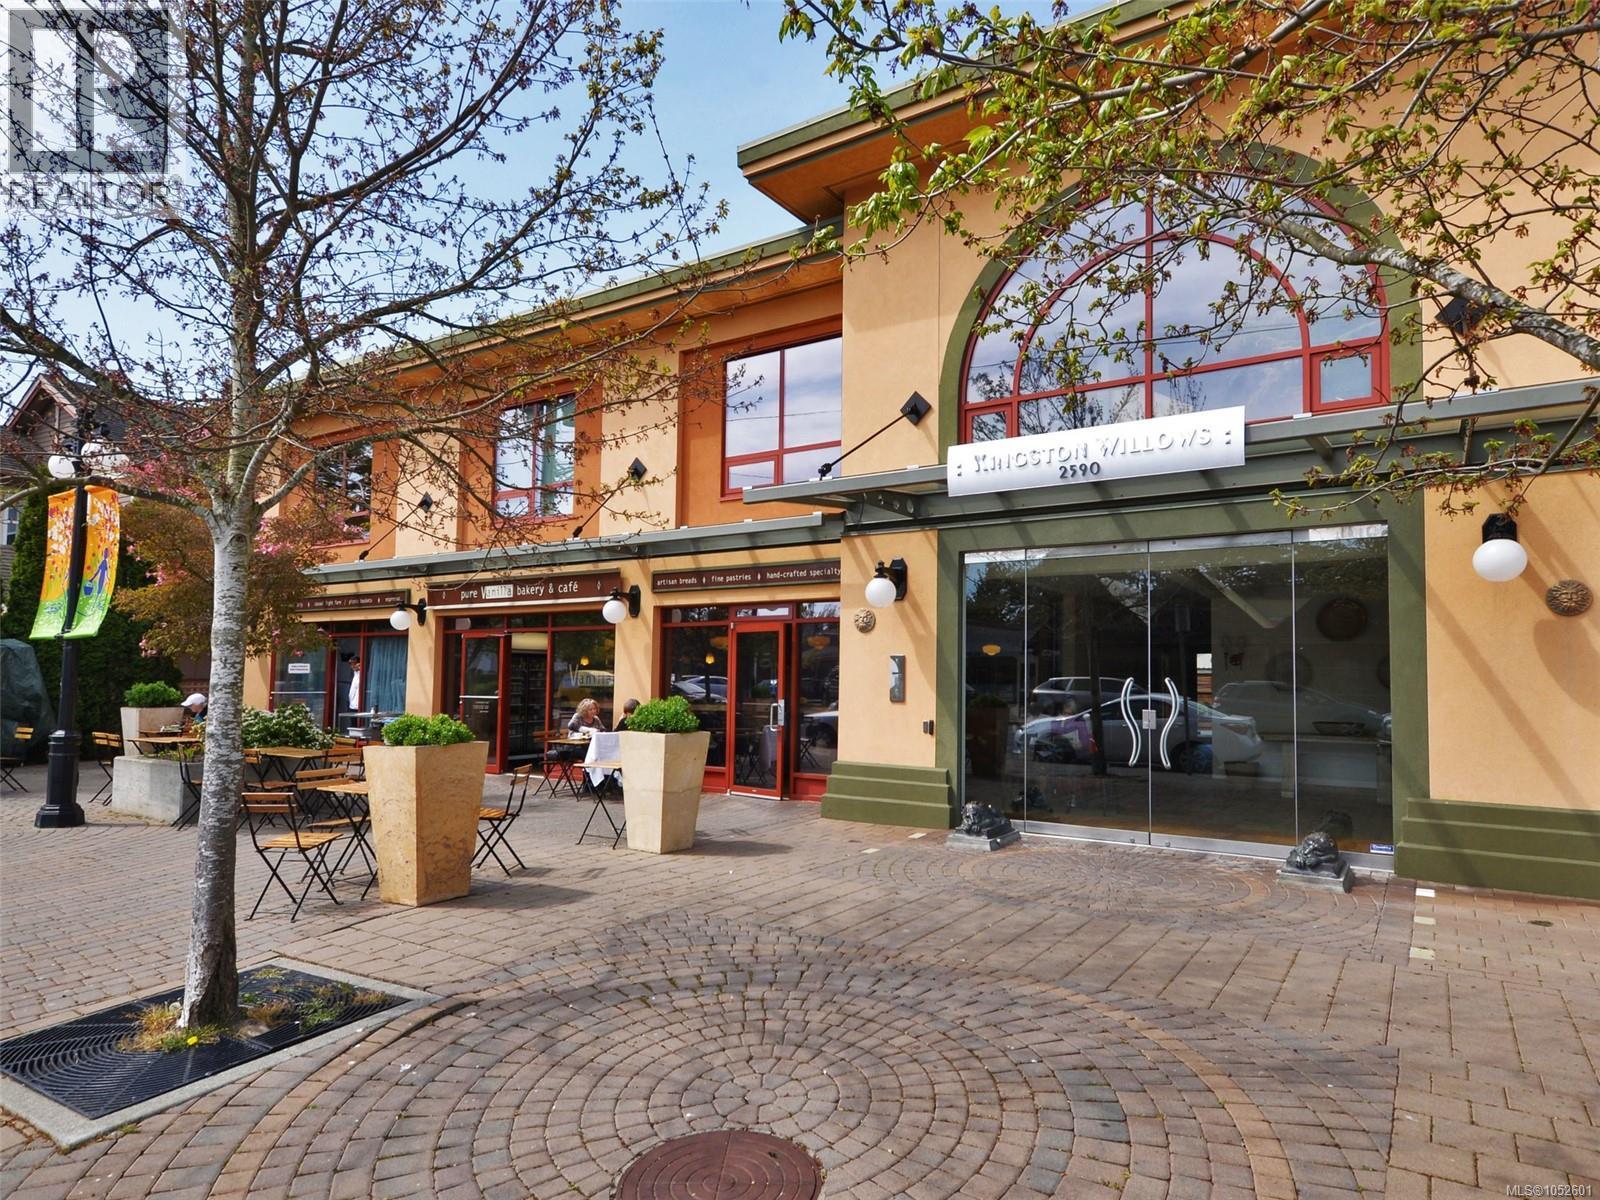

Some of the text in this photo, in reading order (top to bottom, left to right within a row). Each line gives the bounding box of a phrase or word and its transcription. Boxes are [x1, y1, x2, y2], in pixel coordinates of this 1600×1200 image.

[973, 428, 1213, 473] KINGSTON WILLOWS
[1058, 461, 1101, 479] 2590
[656, 567, 841, 586] artisan breads fine pastries hand-crafted specialty
[460, 589, 478, 600] pure
[516, 584, 545, 597] bakery
[548, 582, 554, 593] &
[557, 581, 578, 593] café
